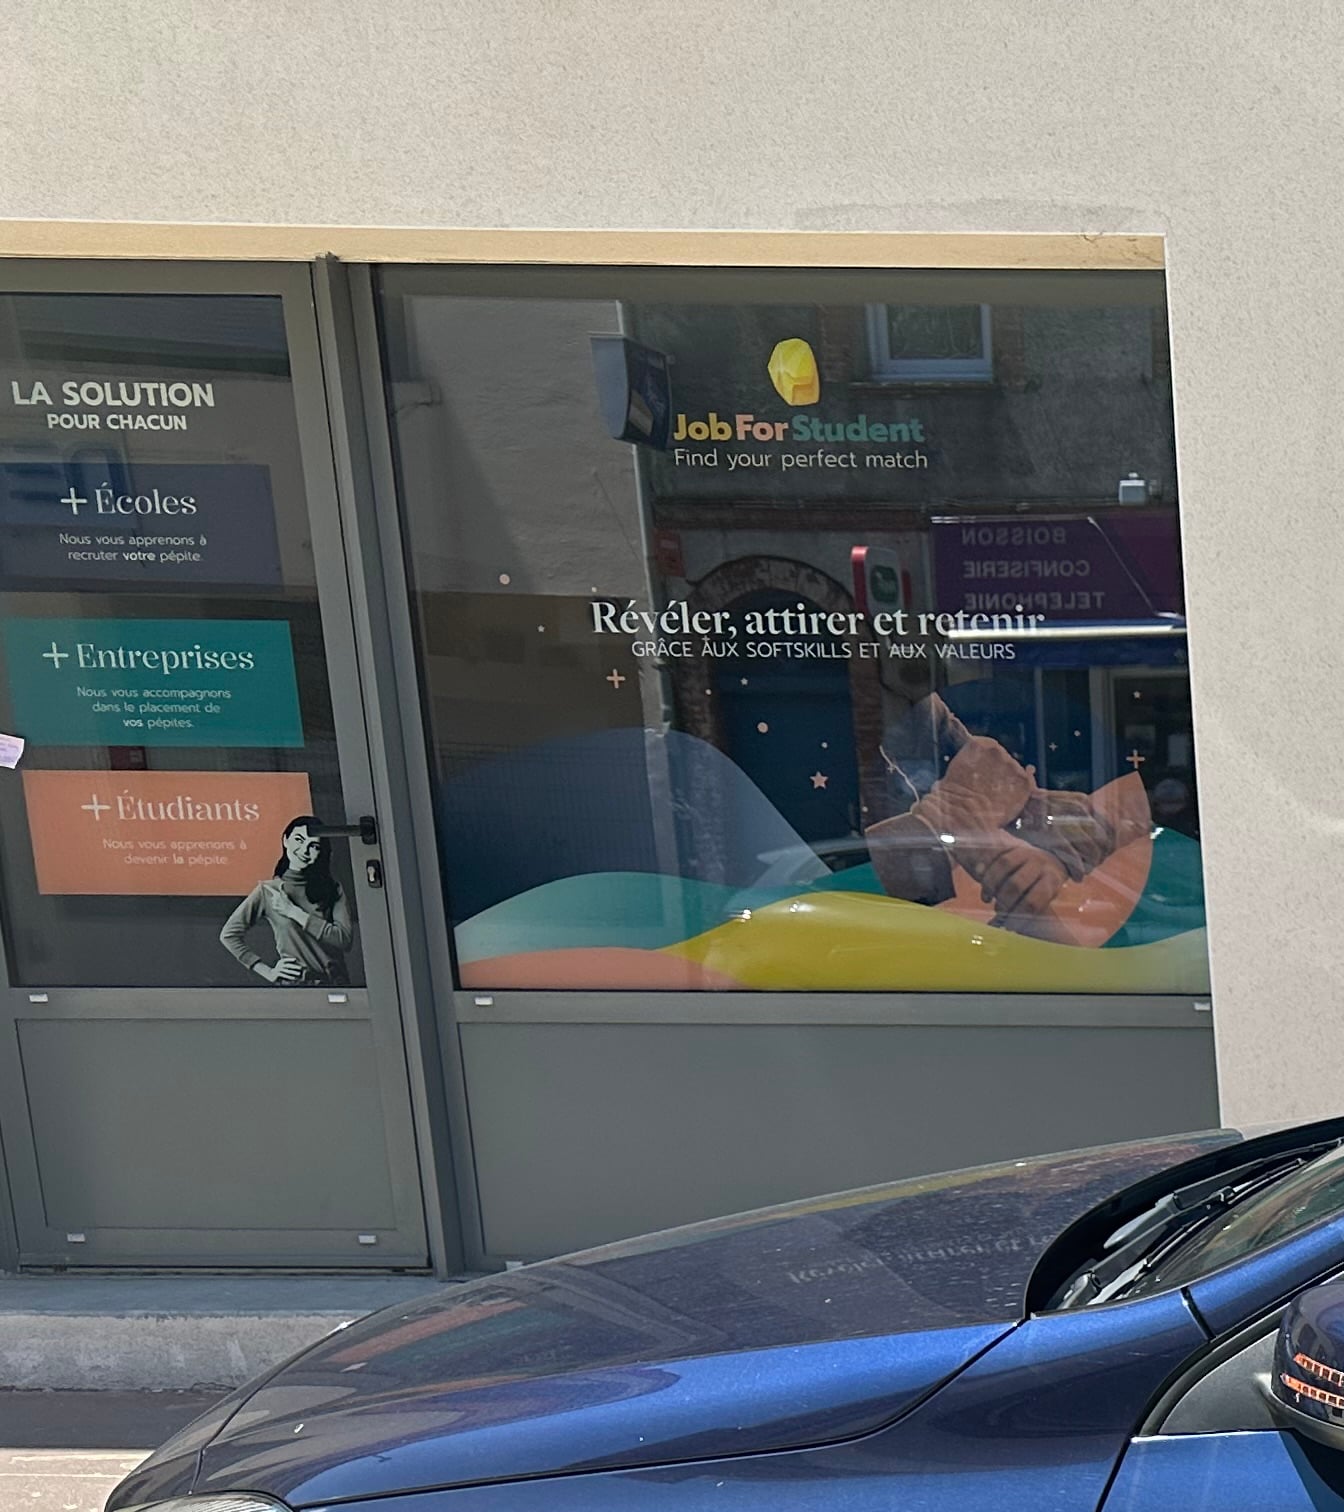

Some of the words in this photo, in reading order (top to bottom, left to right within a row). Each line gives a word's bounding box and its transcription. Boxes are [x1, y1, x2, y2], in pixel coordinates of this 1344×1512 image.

[11, 381, 53, 405] LA
[62, 382, 215, 407] SOLUTION
[47, 414, 101, 430] POUR
[106, 415, 187, 430] CHACUN
[674, 449, 718, 467] Find
[727, 453, 771, 471] your
[780, 449, 858, 472] perfect
[865, 451, 928, 468] match
[59, 533, 91, 545] Nous
[95, 535, 125, 545] vous
[128, 534, 195, 548] apprenons
[199, 534, 207, 546] à
[68, 551, 118, 561] recruter
[122, 551, 156, 562] votre
[591, 600, 737, 639] Révéler,
[744, 603, 864, 635] attirer
[872, 609, 907, 635] et
[631, 639, 694, 657] GRÂCE
[701, 641, 740, 657] AUX
[746, 641, 852, 658] SOFTSKILLS
[859, 643, 880, 658] ET
[889, 642, 926, 659] AUX
[935, 643, 1016, 659] VALEURS
[76, 686, 107, 697] Nous
[111, 688, 138, 697] vous
[142, 688, 231, 700] accompagnons
[91, 700, 121, 712] dans
[124, 701, 135, 712] le
[139, 702, 201, 715] placement
[204, 702, 221, 713] de
[122, 718, 144, 727] vos
[102, 838, 134, 849] Nous
[138, 840, 167, 849] vous
[170, 840, 235, 852] apprenons
[124, 853, 168, 864] devenir
[173, 853, 184, 864] la
